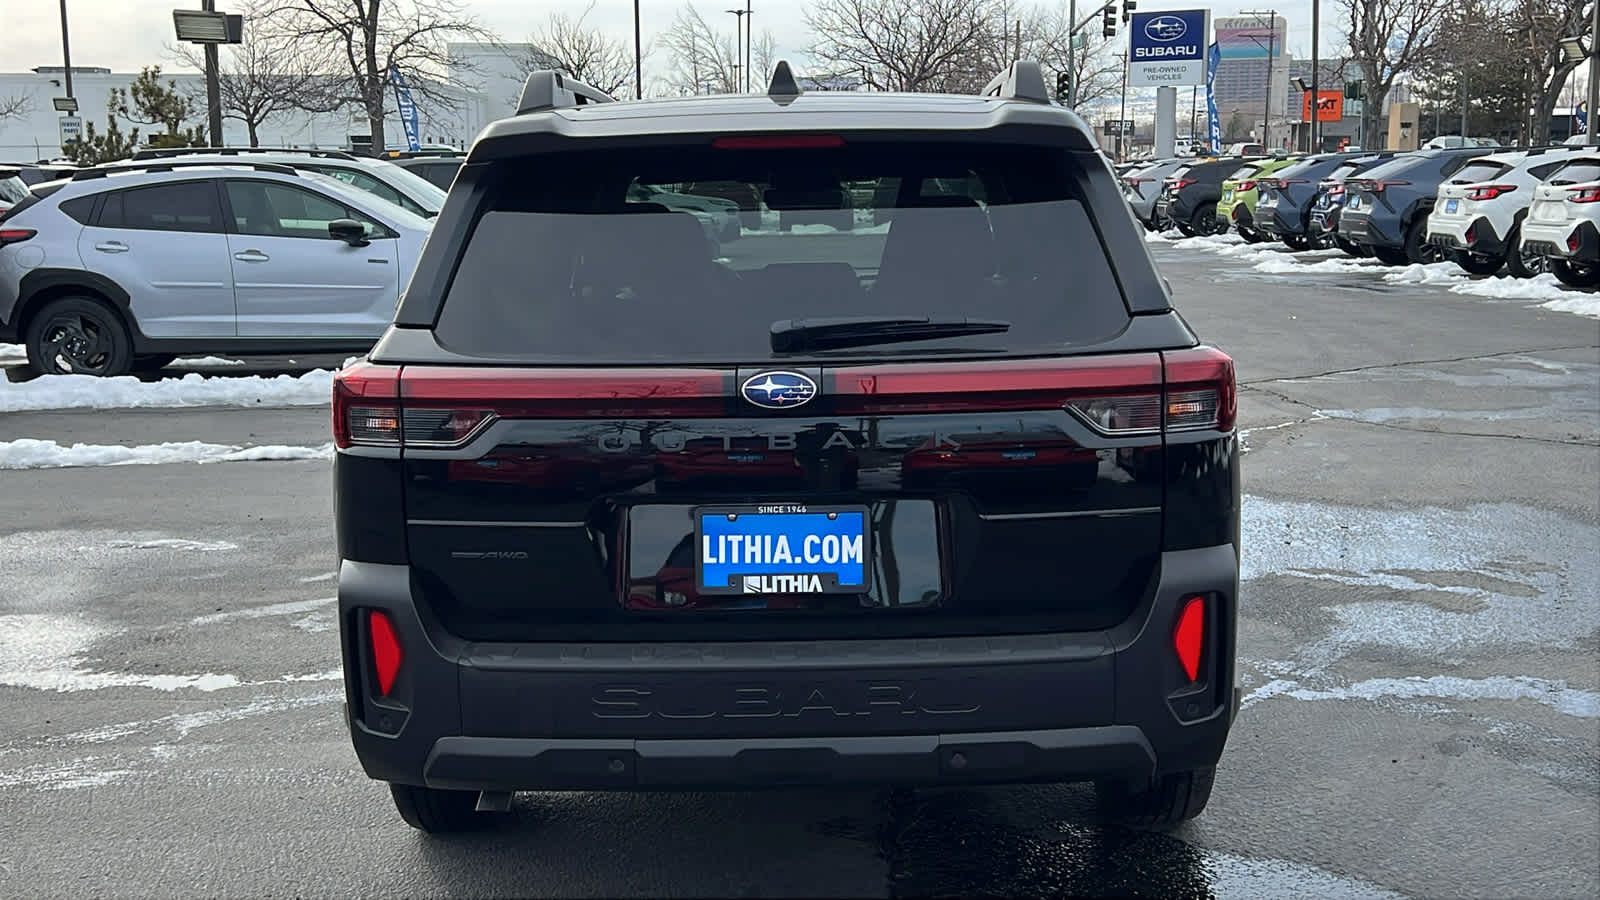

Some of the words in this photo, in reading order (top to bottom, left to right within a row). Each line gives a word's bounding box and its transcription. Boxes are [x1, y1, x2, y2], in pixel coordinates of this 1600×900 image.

[1135, 45, 1197, 57] SUBARU
[1143, 65, 1187, 73] PRE-OWNED
[1146, 73, 1182, 81] VEHICLES
[597, 430, 961, 453] OUTBACK
[758, 505, 785, 514] SINCE
[787, 505, 808, 513] 1946
[480, 551, 529, 560] AWD
[702, 534, 864, 565] LITHIA.COM
[761, 574, 824, 594] LITHIA
[591, 683, 982, 719] SUBARU
